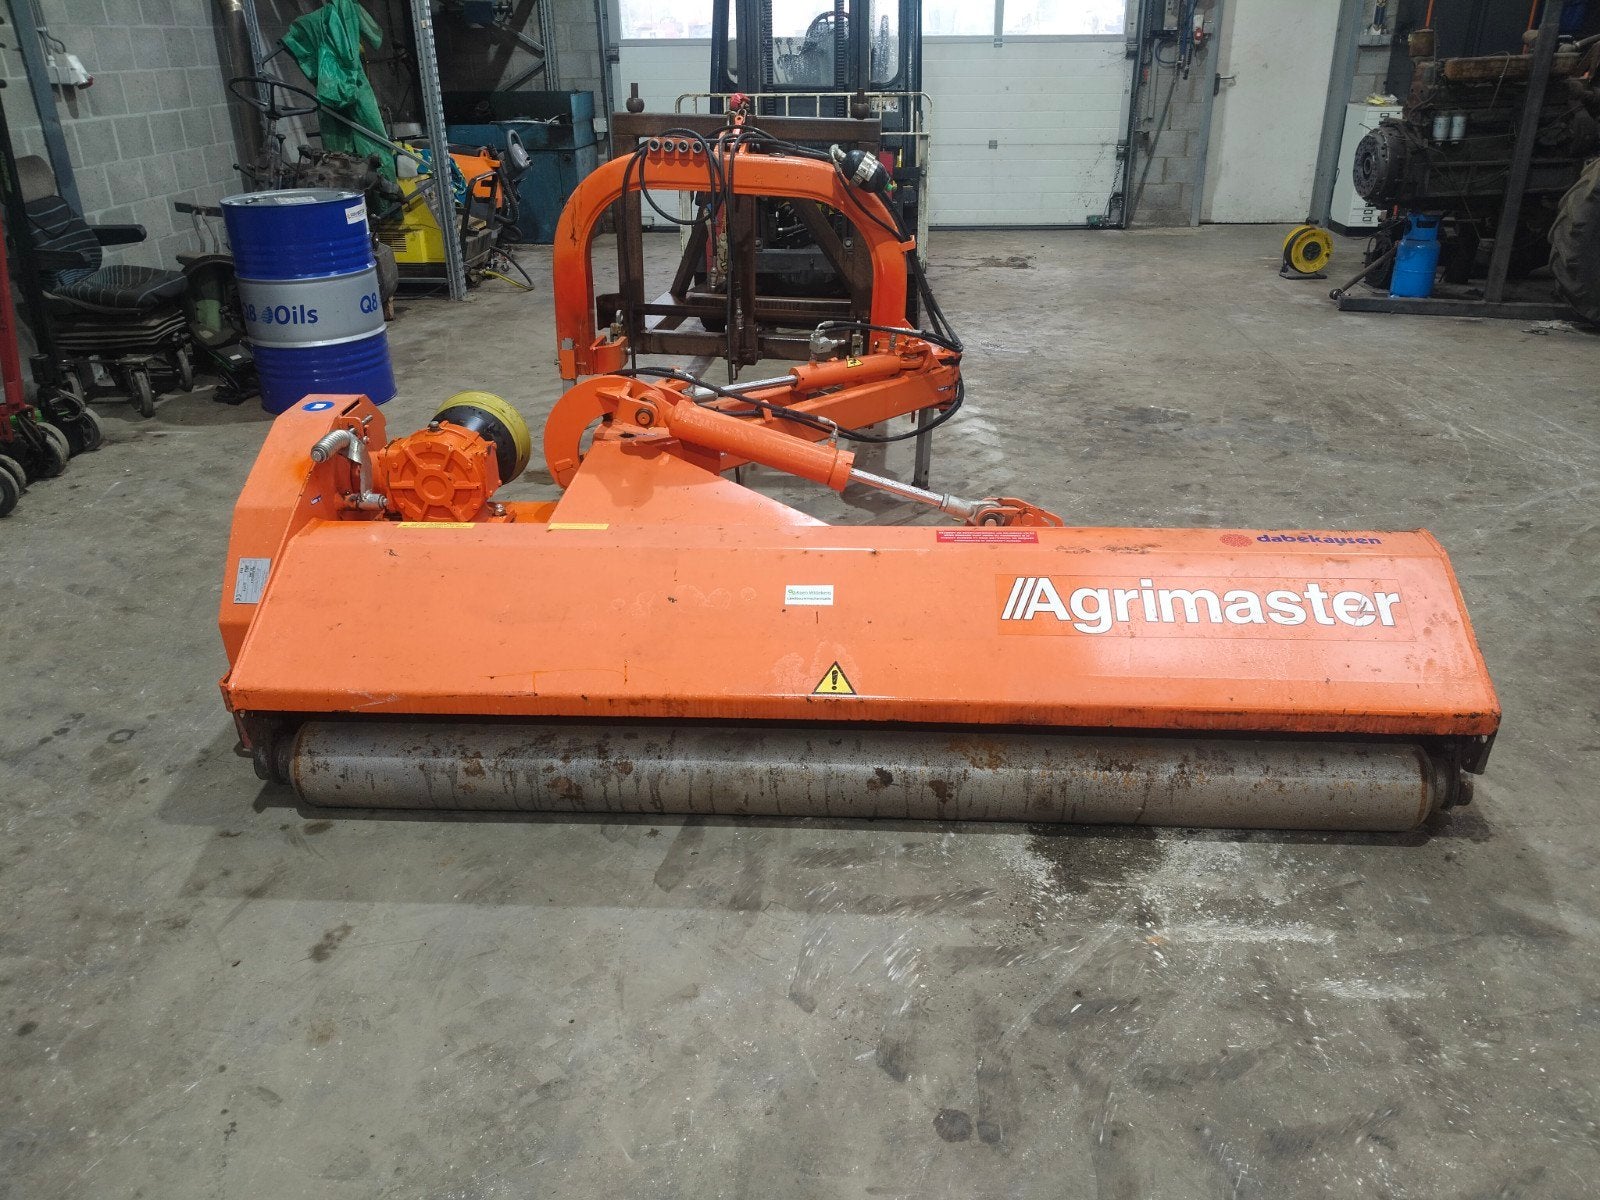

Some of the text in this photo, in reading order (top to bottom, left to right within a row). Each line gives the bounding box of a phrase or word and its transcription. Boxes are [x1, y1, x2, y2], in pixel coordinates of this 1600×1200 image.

[360, 292, 377, 314] Q8
[274, 304, 319, 325] Oils
[1022, 577, 1401, 634] Agrimaster
